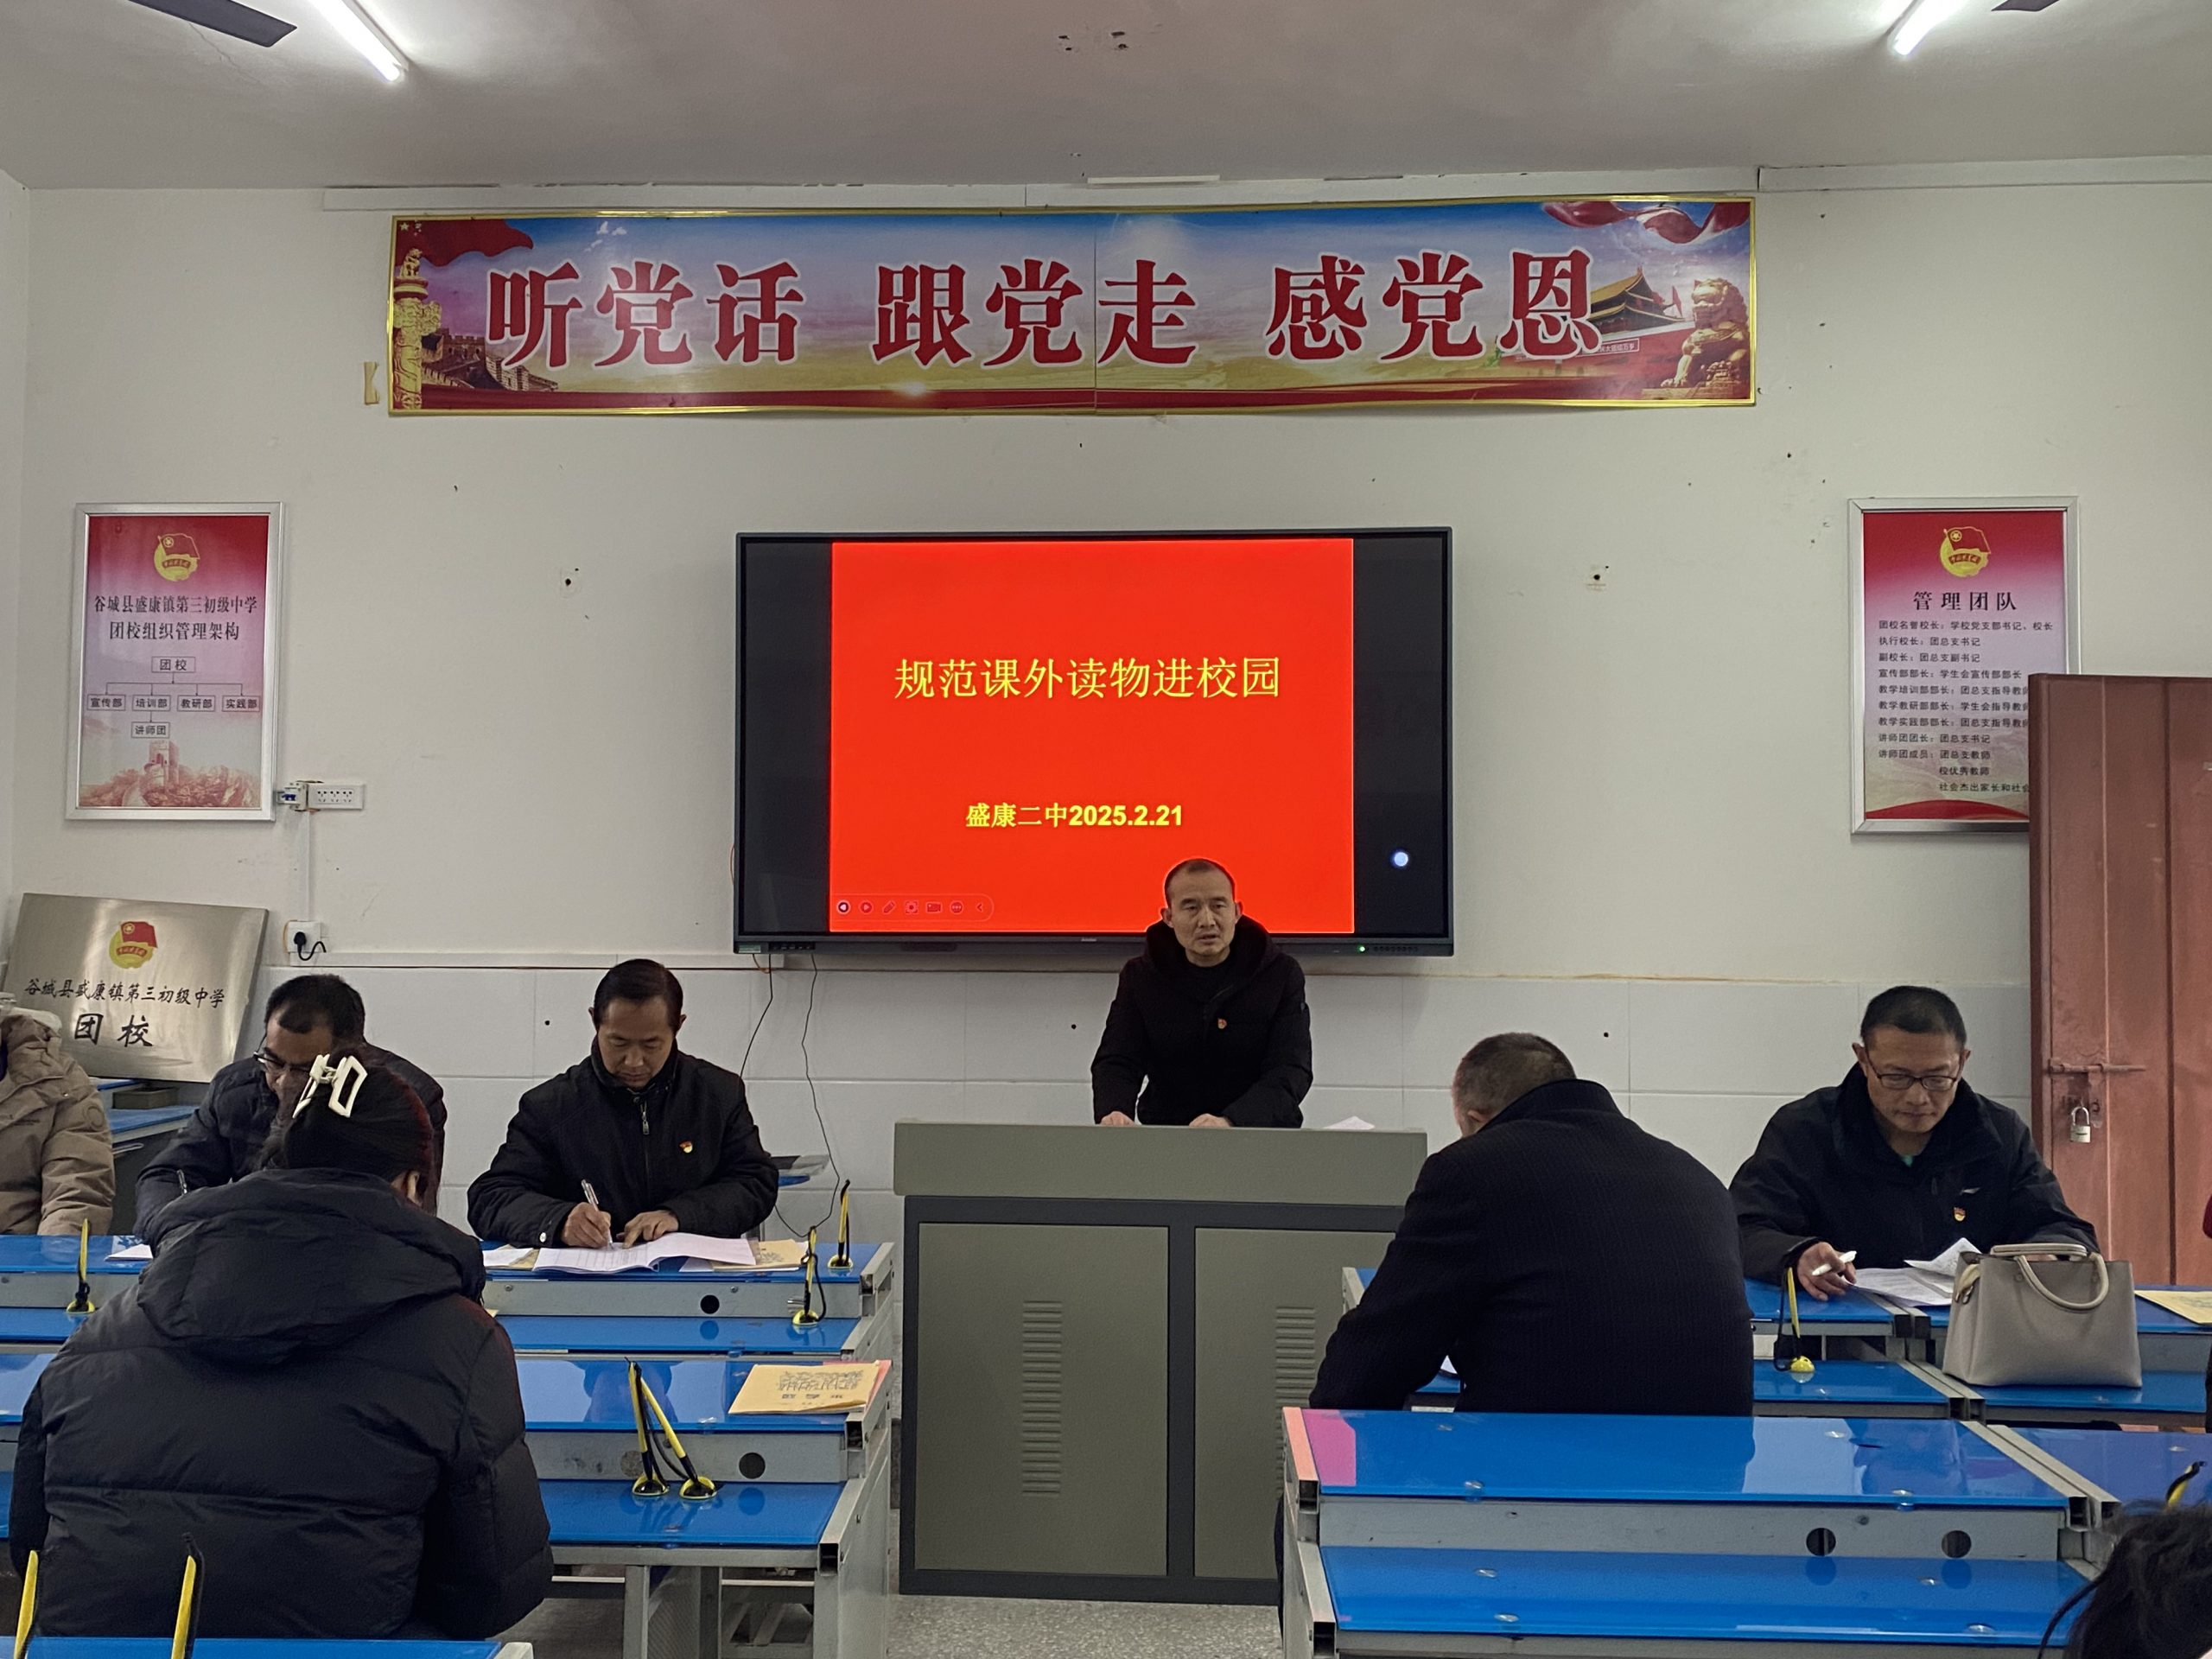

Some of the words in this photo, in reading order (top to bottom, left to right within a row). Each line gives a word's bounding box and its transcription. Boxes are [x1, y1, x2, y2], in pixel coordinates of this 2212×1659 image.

[486, 260, 805, 369] 听党话
[871, 258, 1198, 367] 跟党走
[1264, 251, 1602, 360] 感党恩
[93, 594, 257, 614] 谷城县盛康镇第三初级中学
[1913, 591, 2018, 612] 管理团队
[109, 621, 239, 641] 团校组织管理架构
[159, 658, 188, 671] 团校
[894, 656, 1281, 701] 规范课外读物进校园
[90, 696, 123, 709] 宣传部
[136, 696, 168, 709] 培训部
[181, 697, 213, 710] 教研部
[226, 697, 257, 710] 实践部
[135, 724, 167, 736] 讲师团
[965, 802, 1184, 830] 盛康二中2025.2.21
[74, 1013, 154, 1048] 团校
